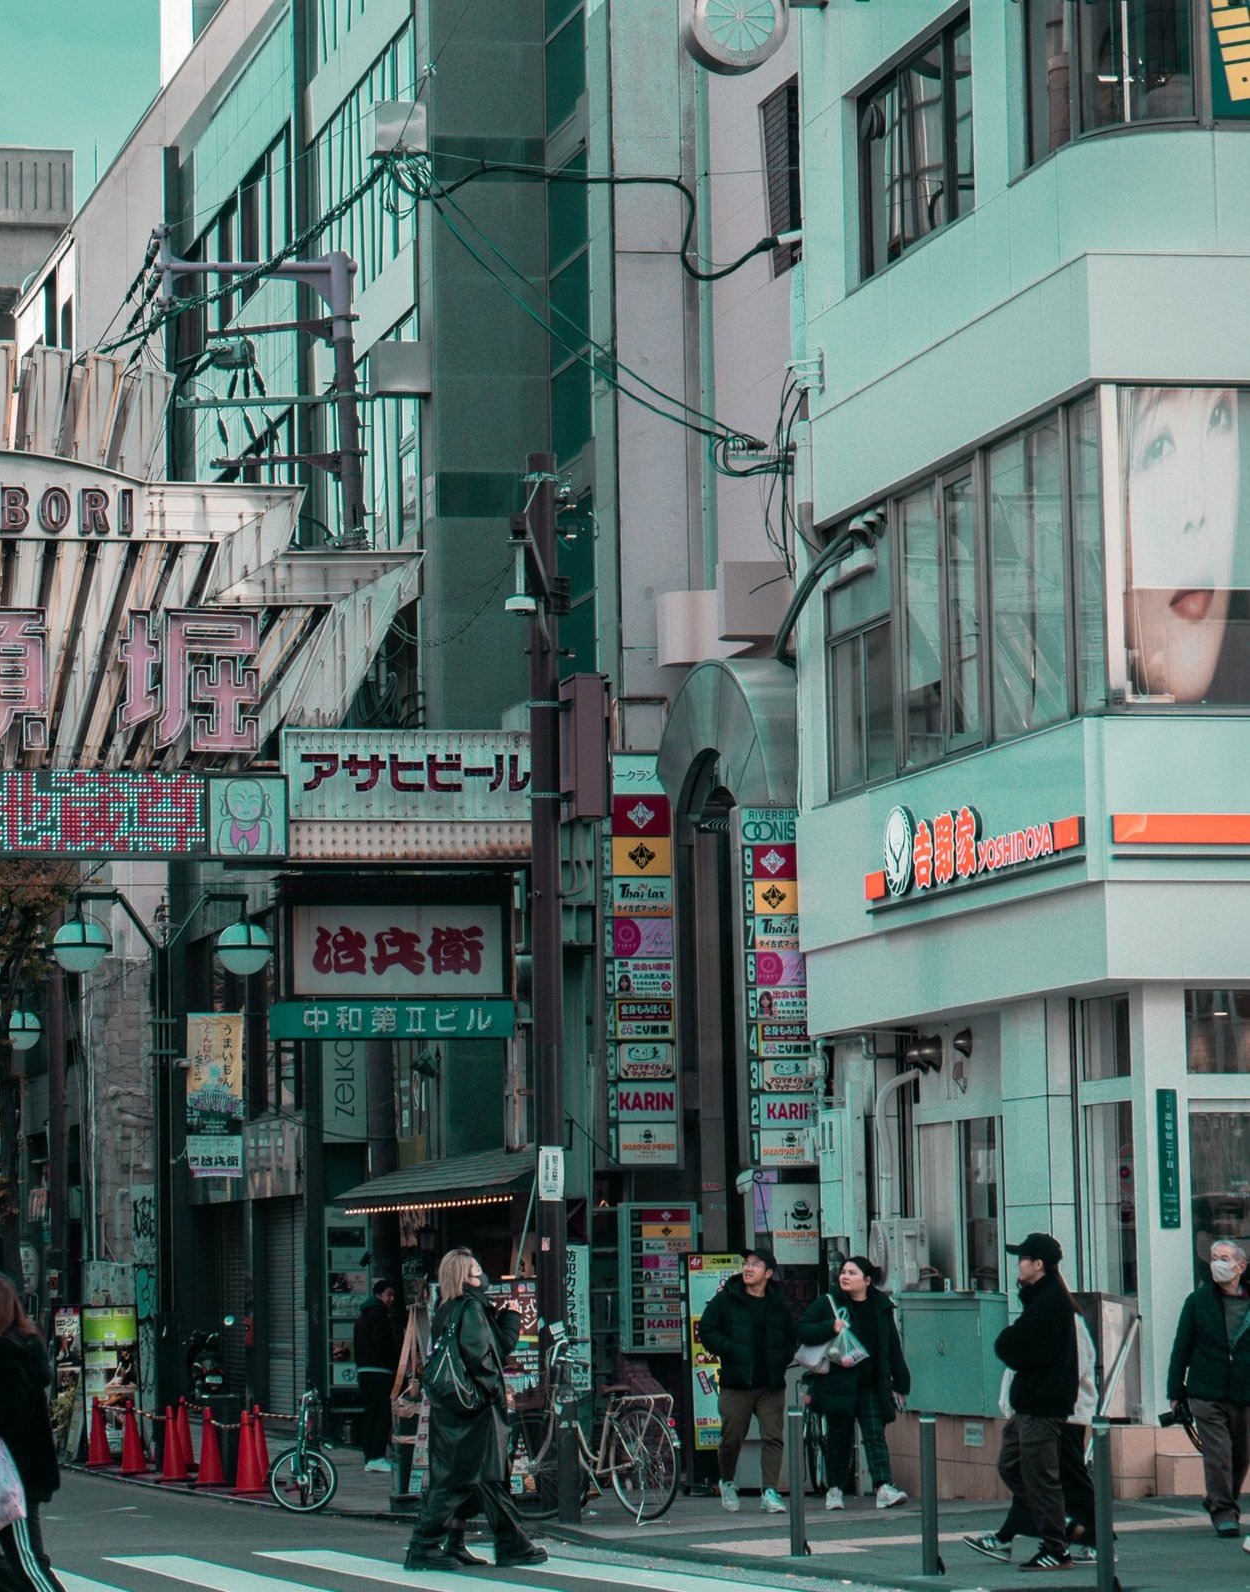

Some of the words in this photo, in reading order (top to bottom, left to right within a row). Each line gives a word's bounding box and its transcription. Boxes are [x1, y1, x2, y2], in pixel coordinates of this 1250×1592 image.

[300, 752, 530, 793] アサヒビール
[744, 847, 754, 876] 9
[913, 805, 976, 889] 吉野家
[977, 822, 1054, 874] YOSHINOYA
[745, 883, 754, 911] 8
[746, 918, 754, 947] 7
[312, 926, 484, 976] 治兵衛
[747, 954, 756, 982] 6
[748, 989, 757, 1018] 5
[203, 1023, 214, 1064] とんぼり
[749, 1025, 758, 1054] 4
[222, 1024, 234, 1088] うまいもん
[750, 1061, 759, 1090] 3
[608, 1086, 617, 1118] 2
[618, 1091, 674, 1112] KARIN
[751, 1097, 759, 1126] 2
[752, 1132, 759, 1161] 1
